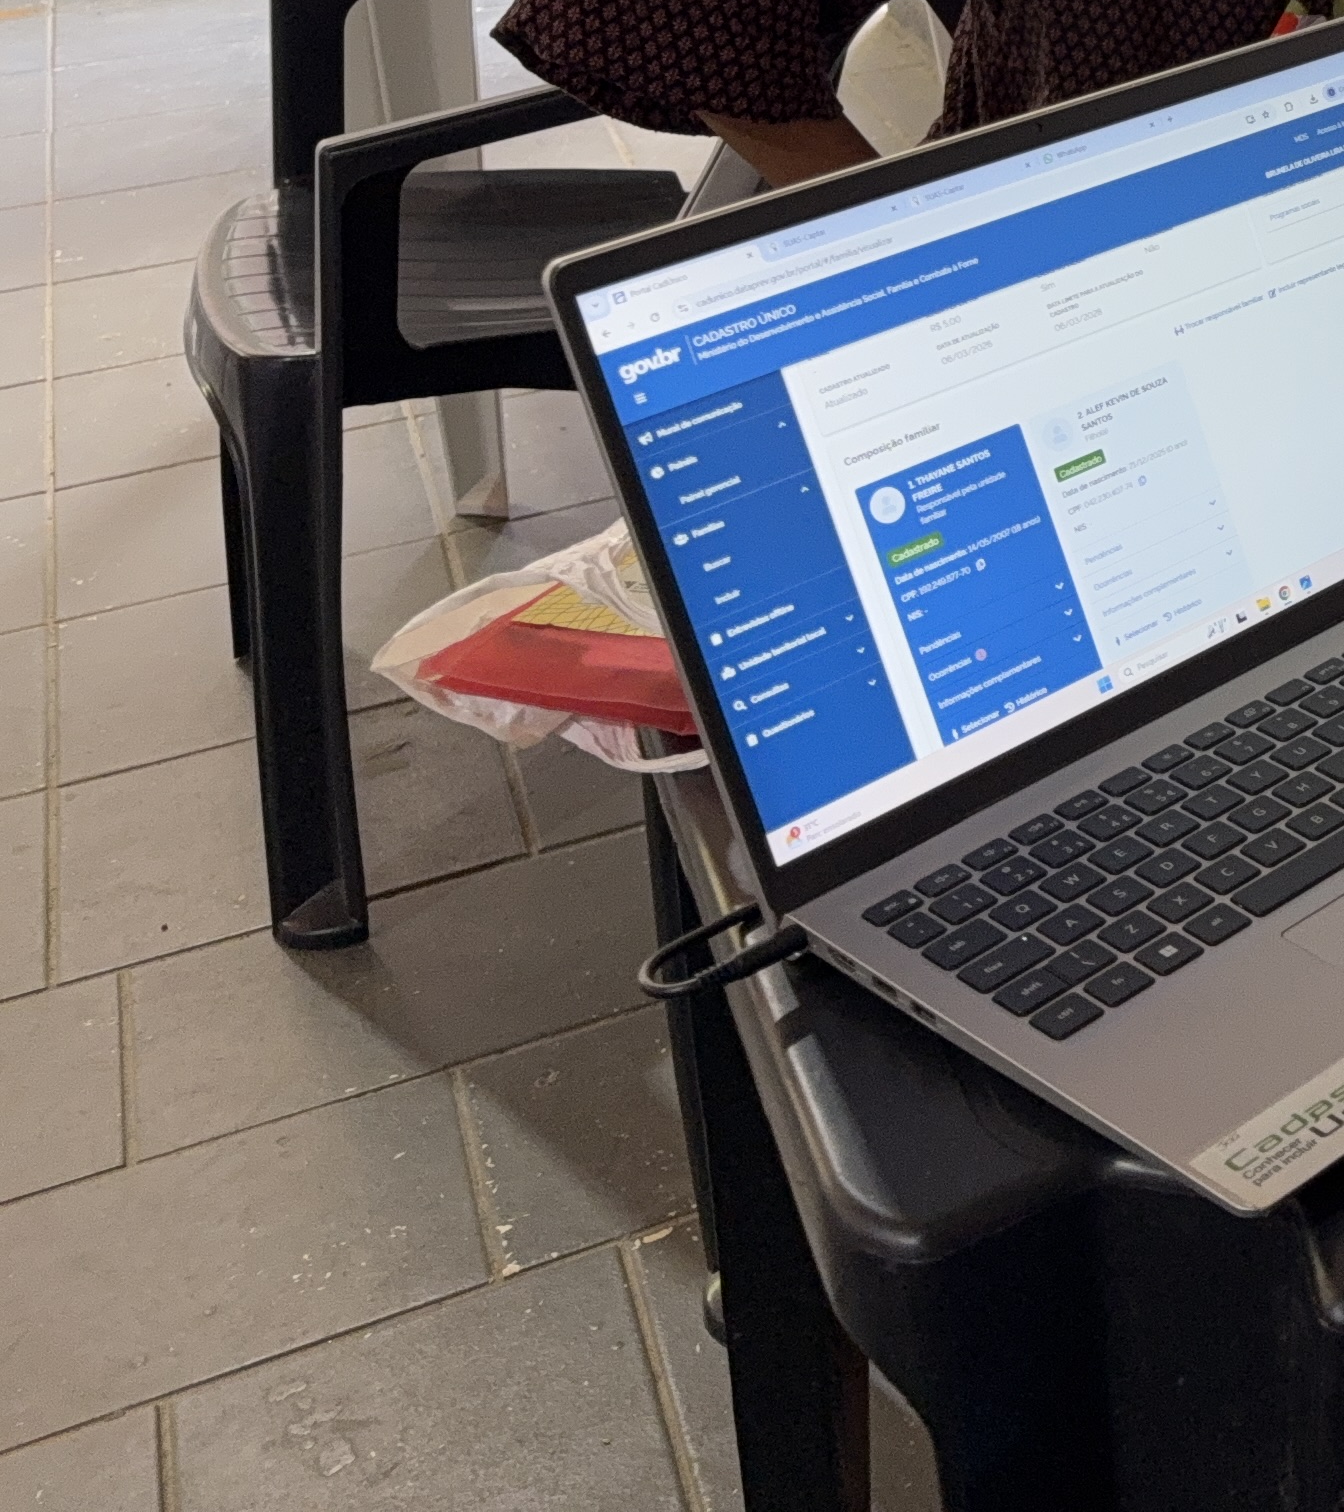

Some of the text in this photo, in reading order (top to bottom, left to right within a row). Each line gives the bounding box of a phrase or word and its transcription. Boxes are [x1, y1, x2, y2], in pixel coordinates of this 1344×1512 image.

[693, 305, 796, 346] CADASTRO ÚNICO
[825, 388, 868, 409] Atualizado
[1105, 394, 1129, 407] KEVIN
[1130, 388, 1141, 397] DE
[1141, 377, 1168, 392] SOUZA
[1081, 413, 1113, 431] SANTOS
[844, 424, 939, 466] Composição familiar
[915, 464, 956, 485] THAYANE
[956, 449, 990, 469] SANTOS
[1060, 456, 1102, 478] Cadastrado
[912, 483, 943, 502] FREIRE
[892, 539, 939, 562] Cadastrado
[1252, 1164, 1282, 1188] para
